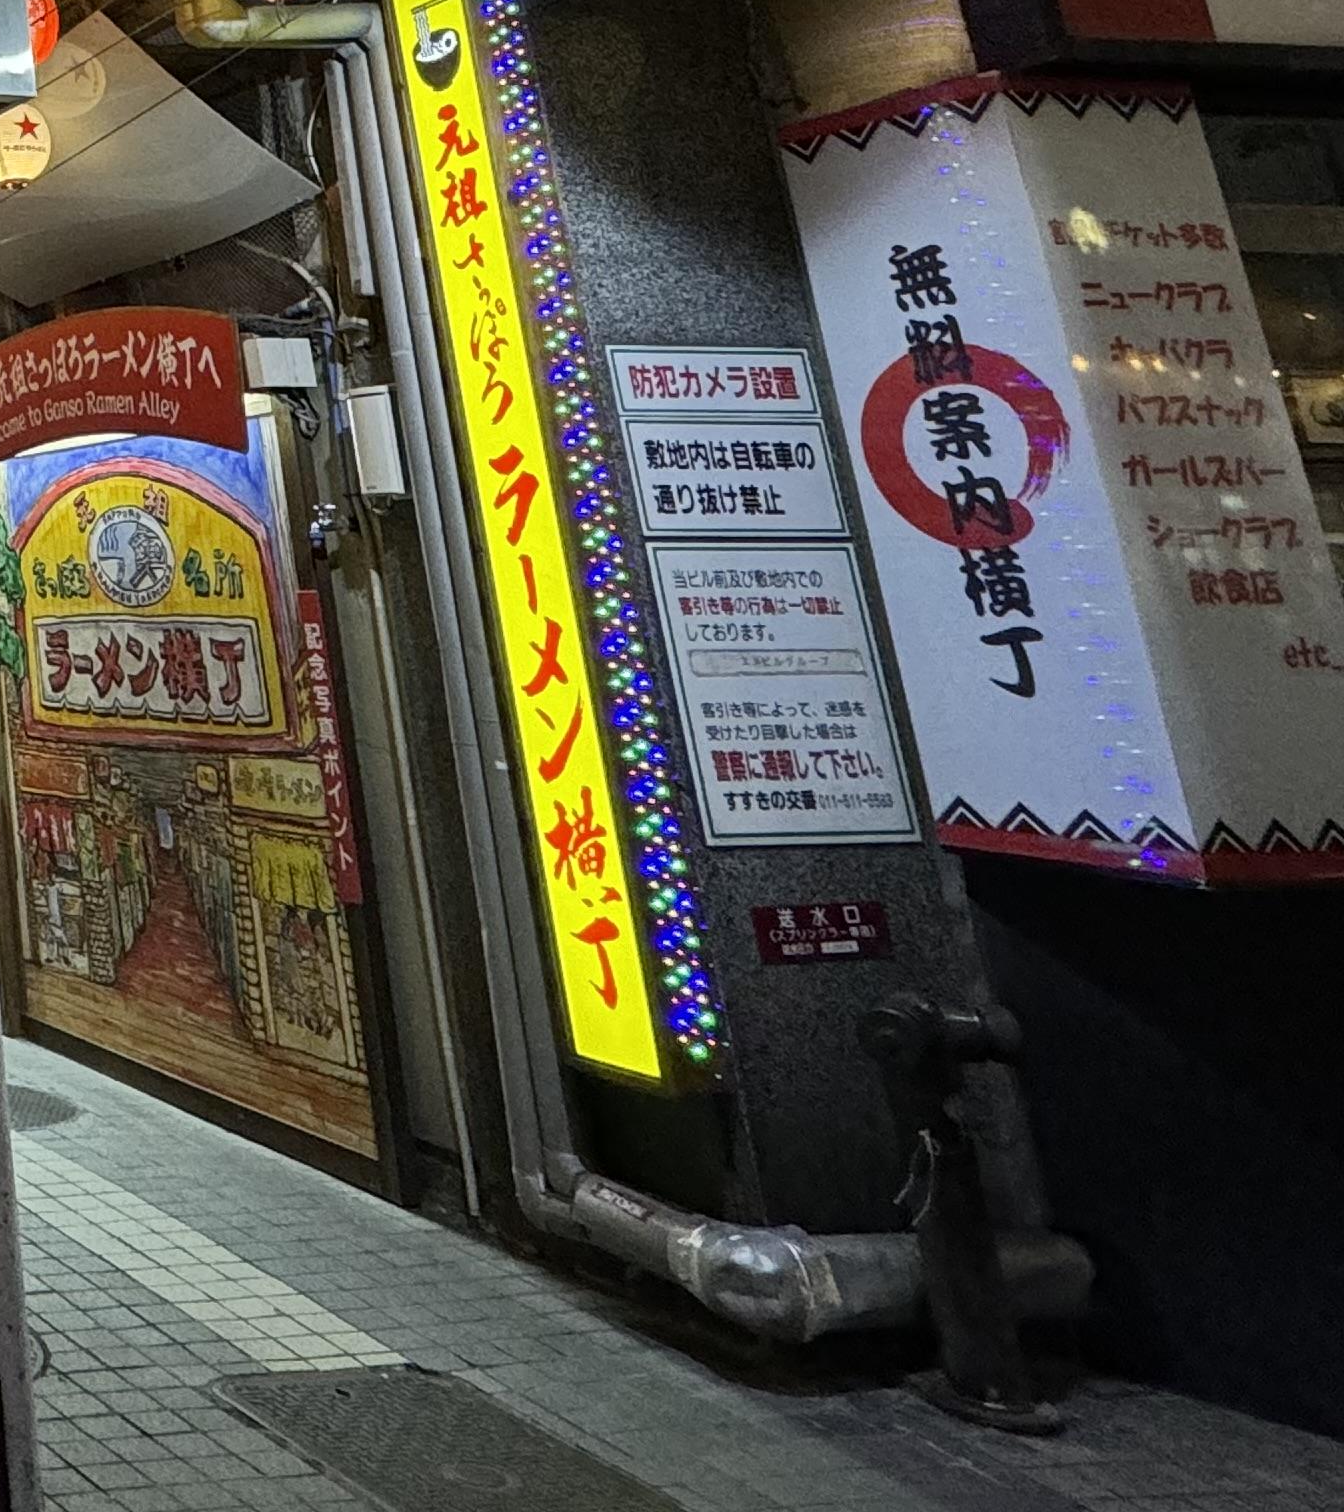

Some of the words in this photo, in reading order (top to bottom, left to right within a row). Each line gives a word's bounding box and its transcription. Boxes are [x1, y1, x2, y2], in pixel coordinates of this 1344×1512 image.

[628, 364, 800, 401] 防犯カメラ設置
[43, 396, 84, 421] Ganso
[86, 391, 135, 415] Ramen
[138, 391, 180, 425] Alley
[644, 439, 815, 472] 敷地内は自転車の
[889, 244, 1044, 698] 無料案内横丁
[652, 485, 786, 516] 通り抜け禁止
[679, 596, 844, 616] 客引き等の行為は一切禁止
[685, 623, 776, 642] しております。
[44, 628, 247, 705] ラーメン横丁
[700, 701, 867, 719] 客引き等によって、迷惑を
[705, 724, 857, 741] 受けたり目撃した場合は
[711, 749, 884, 782] 警察に通報して下さい。
[723, 790, 816, 811] すすきの交番
